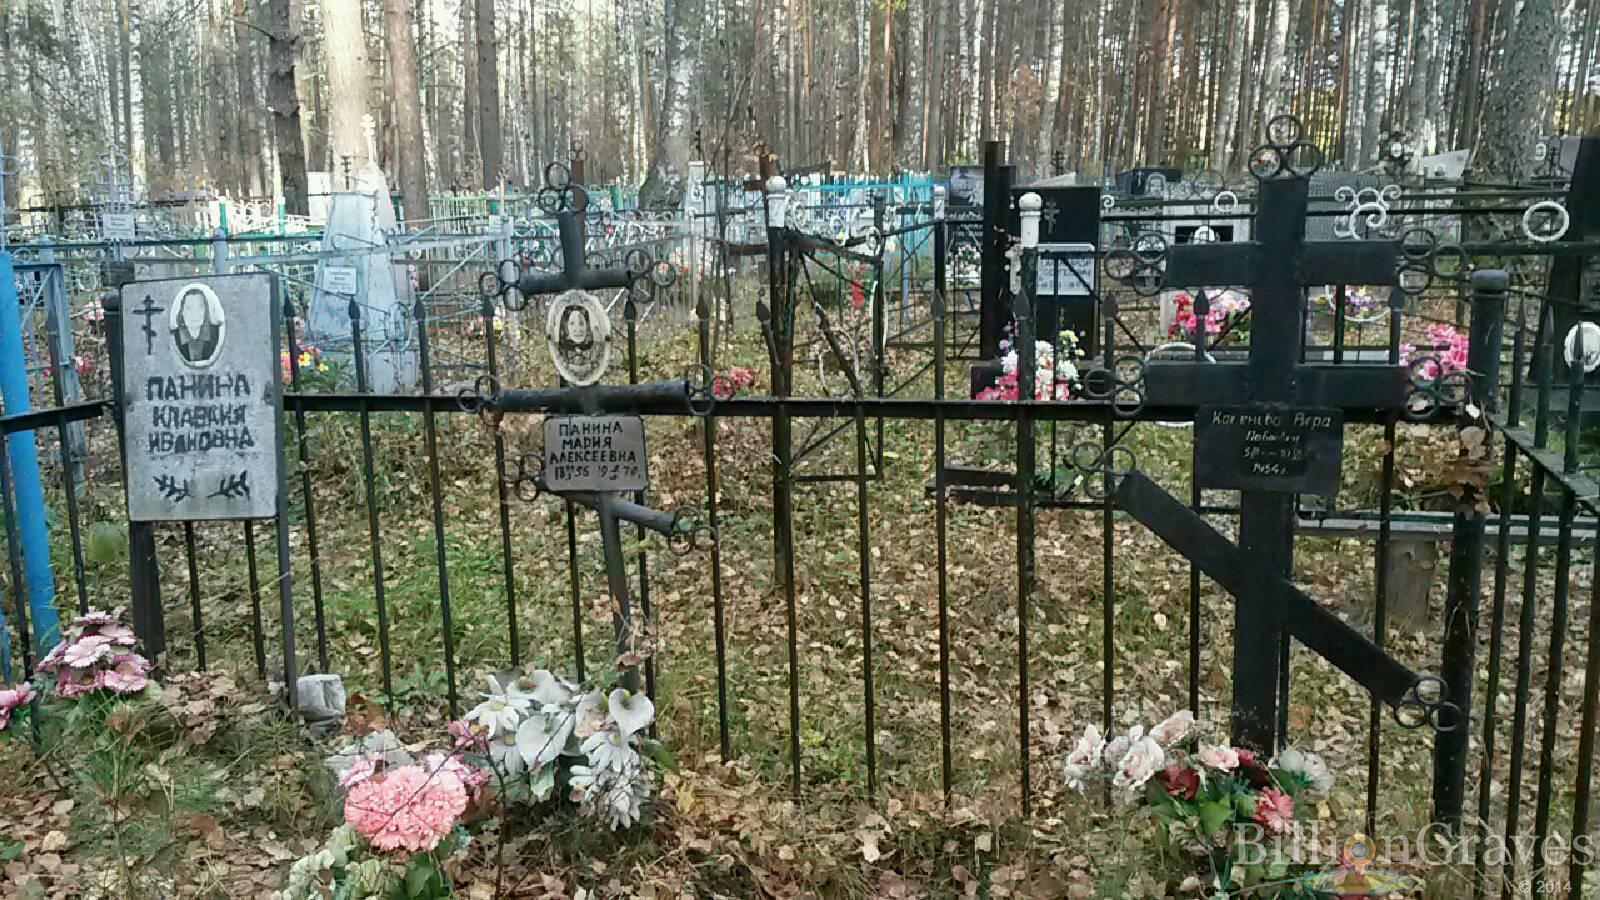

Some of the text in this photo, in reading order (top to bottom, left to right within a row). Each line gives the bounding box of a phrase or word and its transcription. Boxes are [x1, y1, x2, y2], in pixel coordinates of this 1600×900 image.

[146, 372, 251, 400] ПАНИНА
[152, 402, 247, 429] КЛАВДИЯ
[559, 421, 623, 436] ПАНИНА
[148, 426, 255, 453] ИВАНОВНА
[562, 436, 612, 450] МАРИЯ
[549, 450, 636, 464] АЛЕКСЕЕВНА
